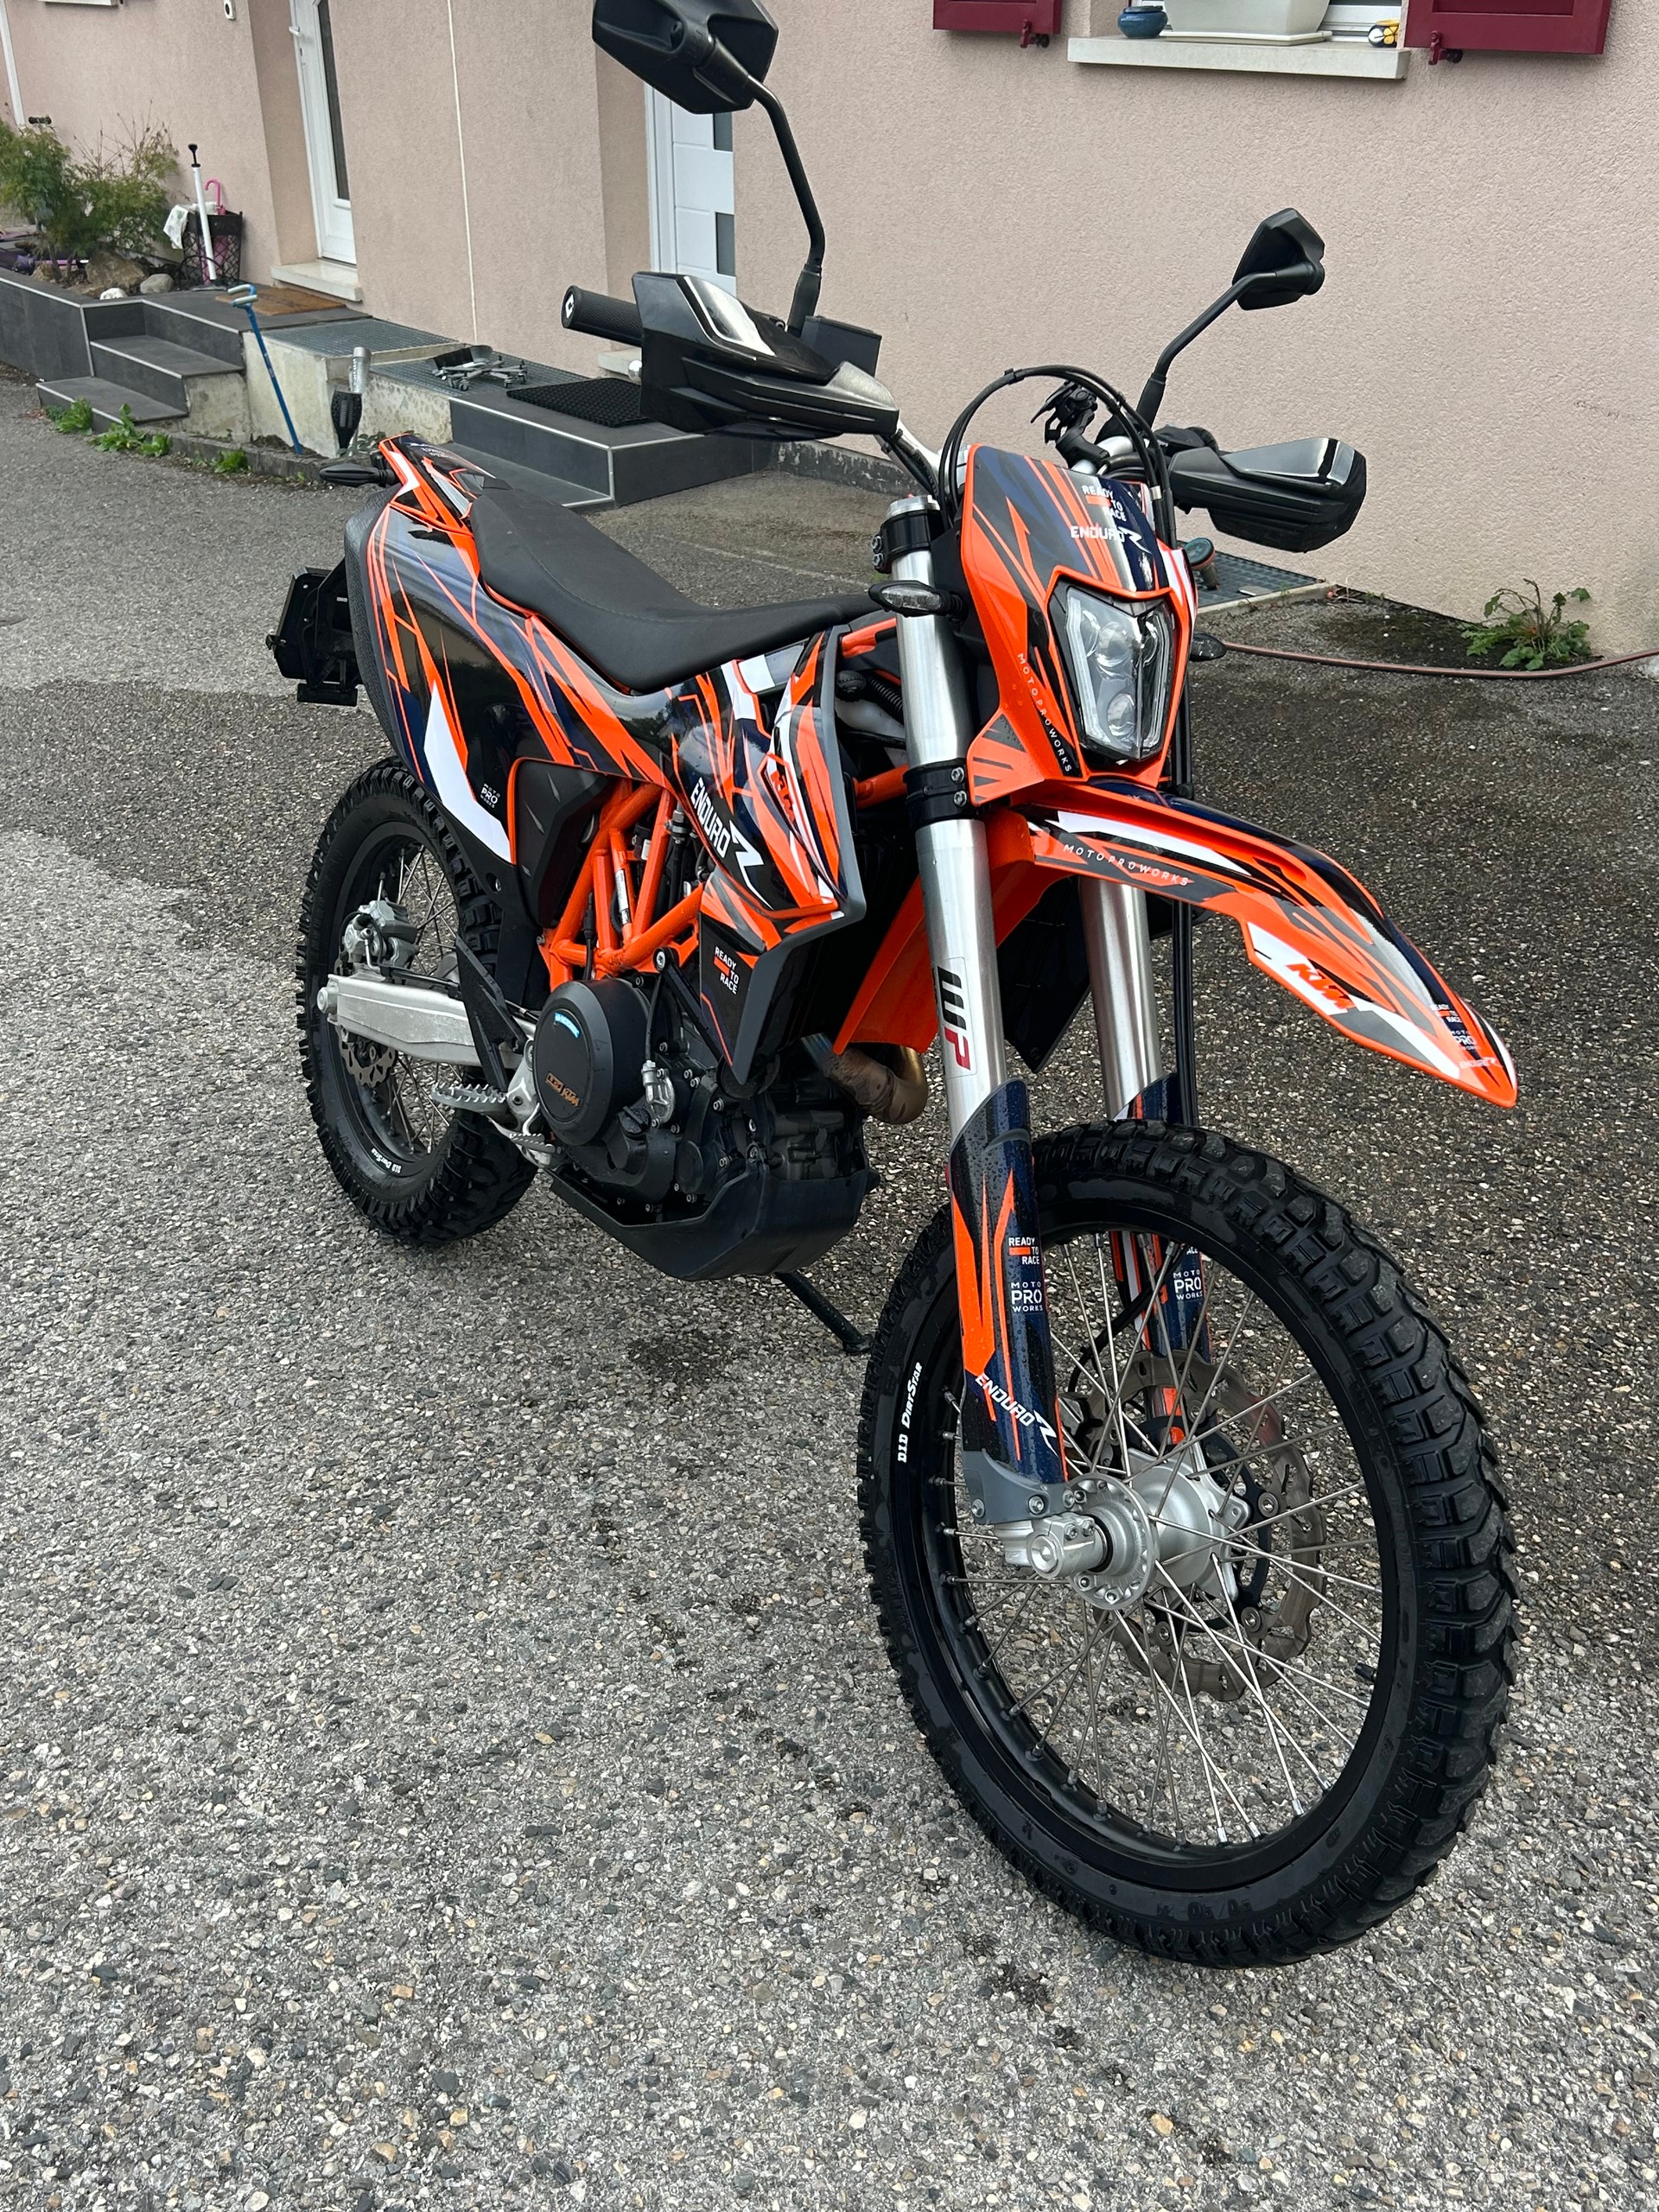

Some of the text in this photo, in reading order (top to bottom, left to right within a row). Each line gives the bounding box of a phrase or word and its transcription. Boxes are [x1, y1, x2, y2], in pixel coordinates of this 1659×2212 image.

[1110, 500, 1123, 512] TO
[1071, 525, 1125, 543] ENDURO
[481, 787, 499, 804] PRO
[690, 778, 731, 858] ENDURO
[1063, 844, 1188, 887] MOTOPROWORKS
[715, 946, 737, 970] READY
[720, 972, 738, 995] RACE
[730, 970, 739, 984] TO
[1285, 963, 1355, 1009] KTM
[1008, 1237, 1035, 1246] READY
[1031, 1247, 1039, 1255] TO
[1022, 1256, 1039, 1265] RACE
[1173, 1269, 1201, 1279] MOTO
[1173, 1276, 1202, 1294] PRO
[1011, 1289, 1042, 1305] PRO
[1176, 1292, 1203, 1300] WORKS
[975, 1372, 1035, 1427] ENDURO
